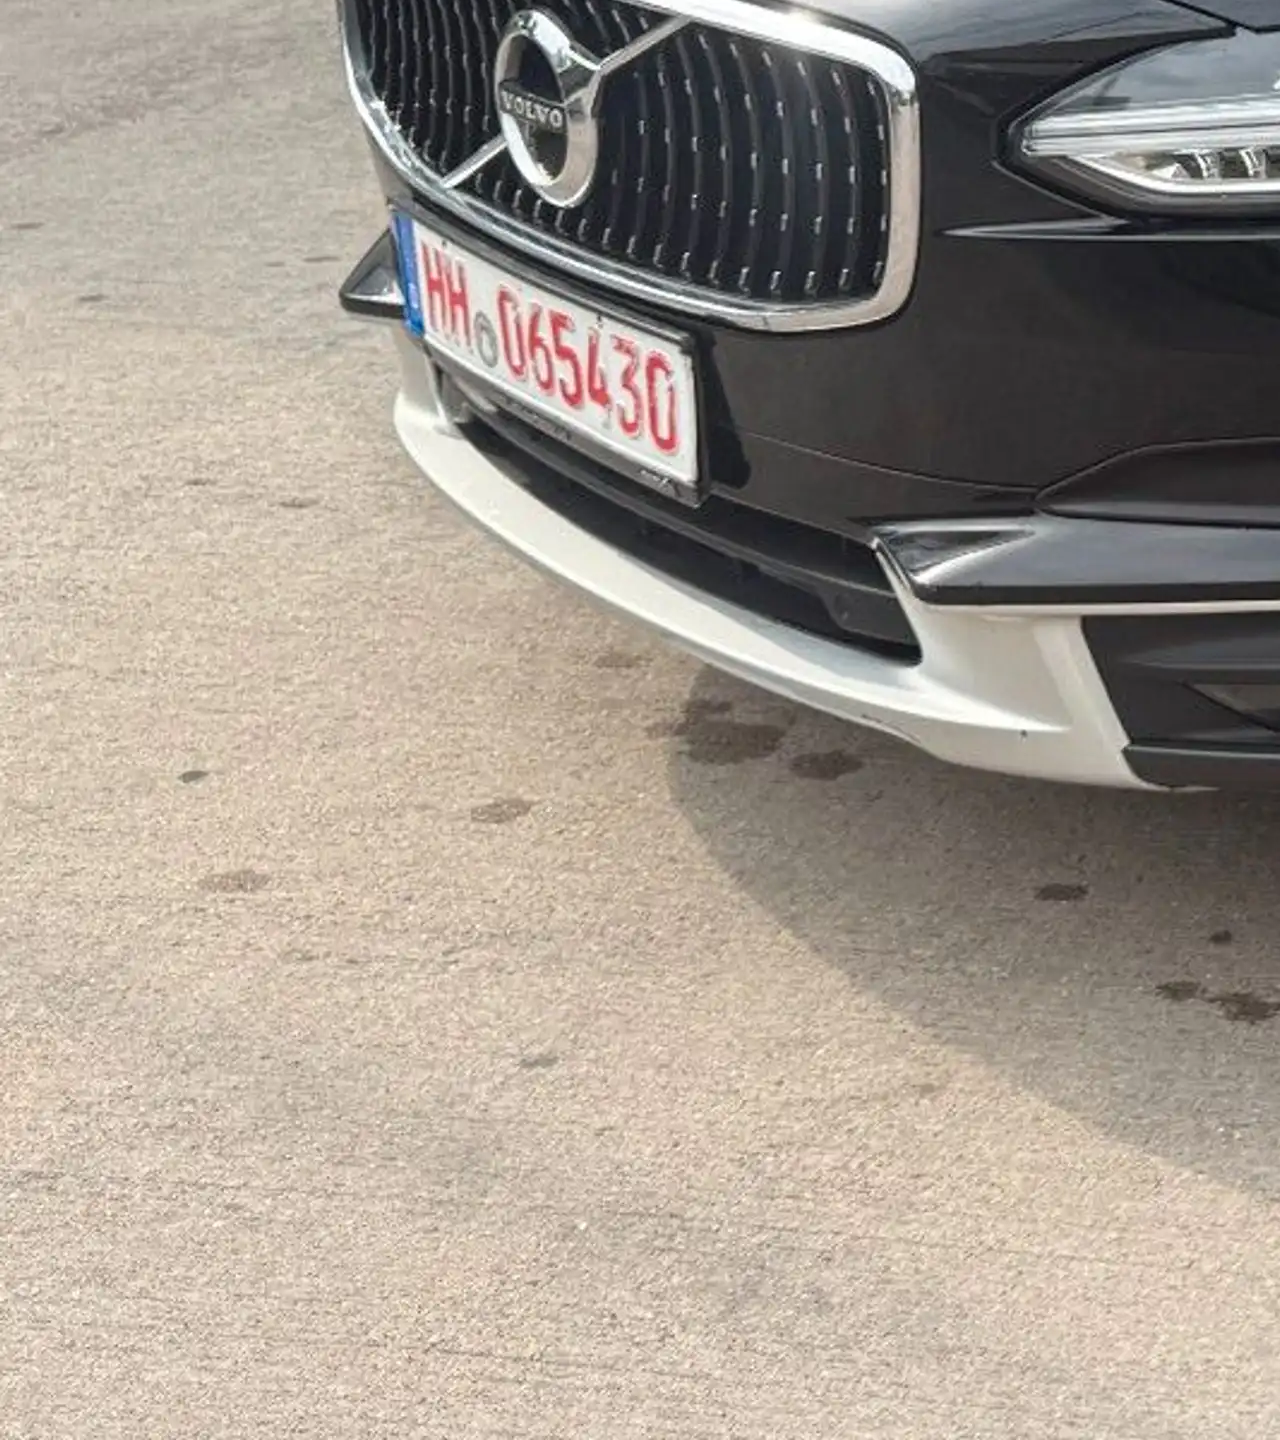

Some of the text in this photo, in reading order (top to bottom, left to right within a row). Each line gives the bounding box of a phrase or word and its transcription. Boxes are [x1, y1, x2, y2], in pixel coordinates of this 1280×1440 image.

[501, 89, 563, 128] VOLVO
[420, 240, 678, 452] HH 065430
